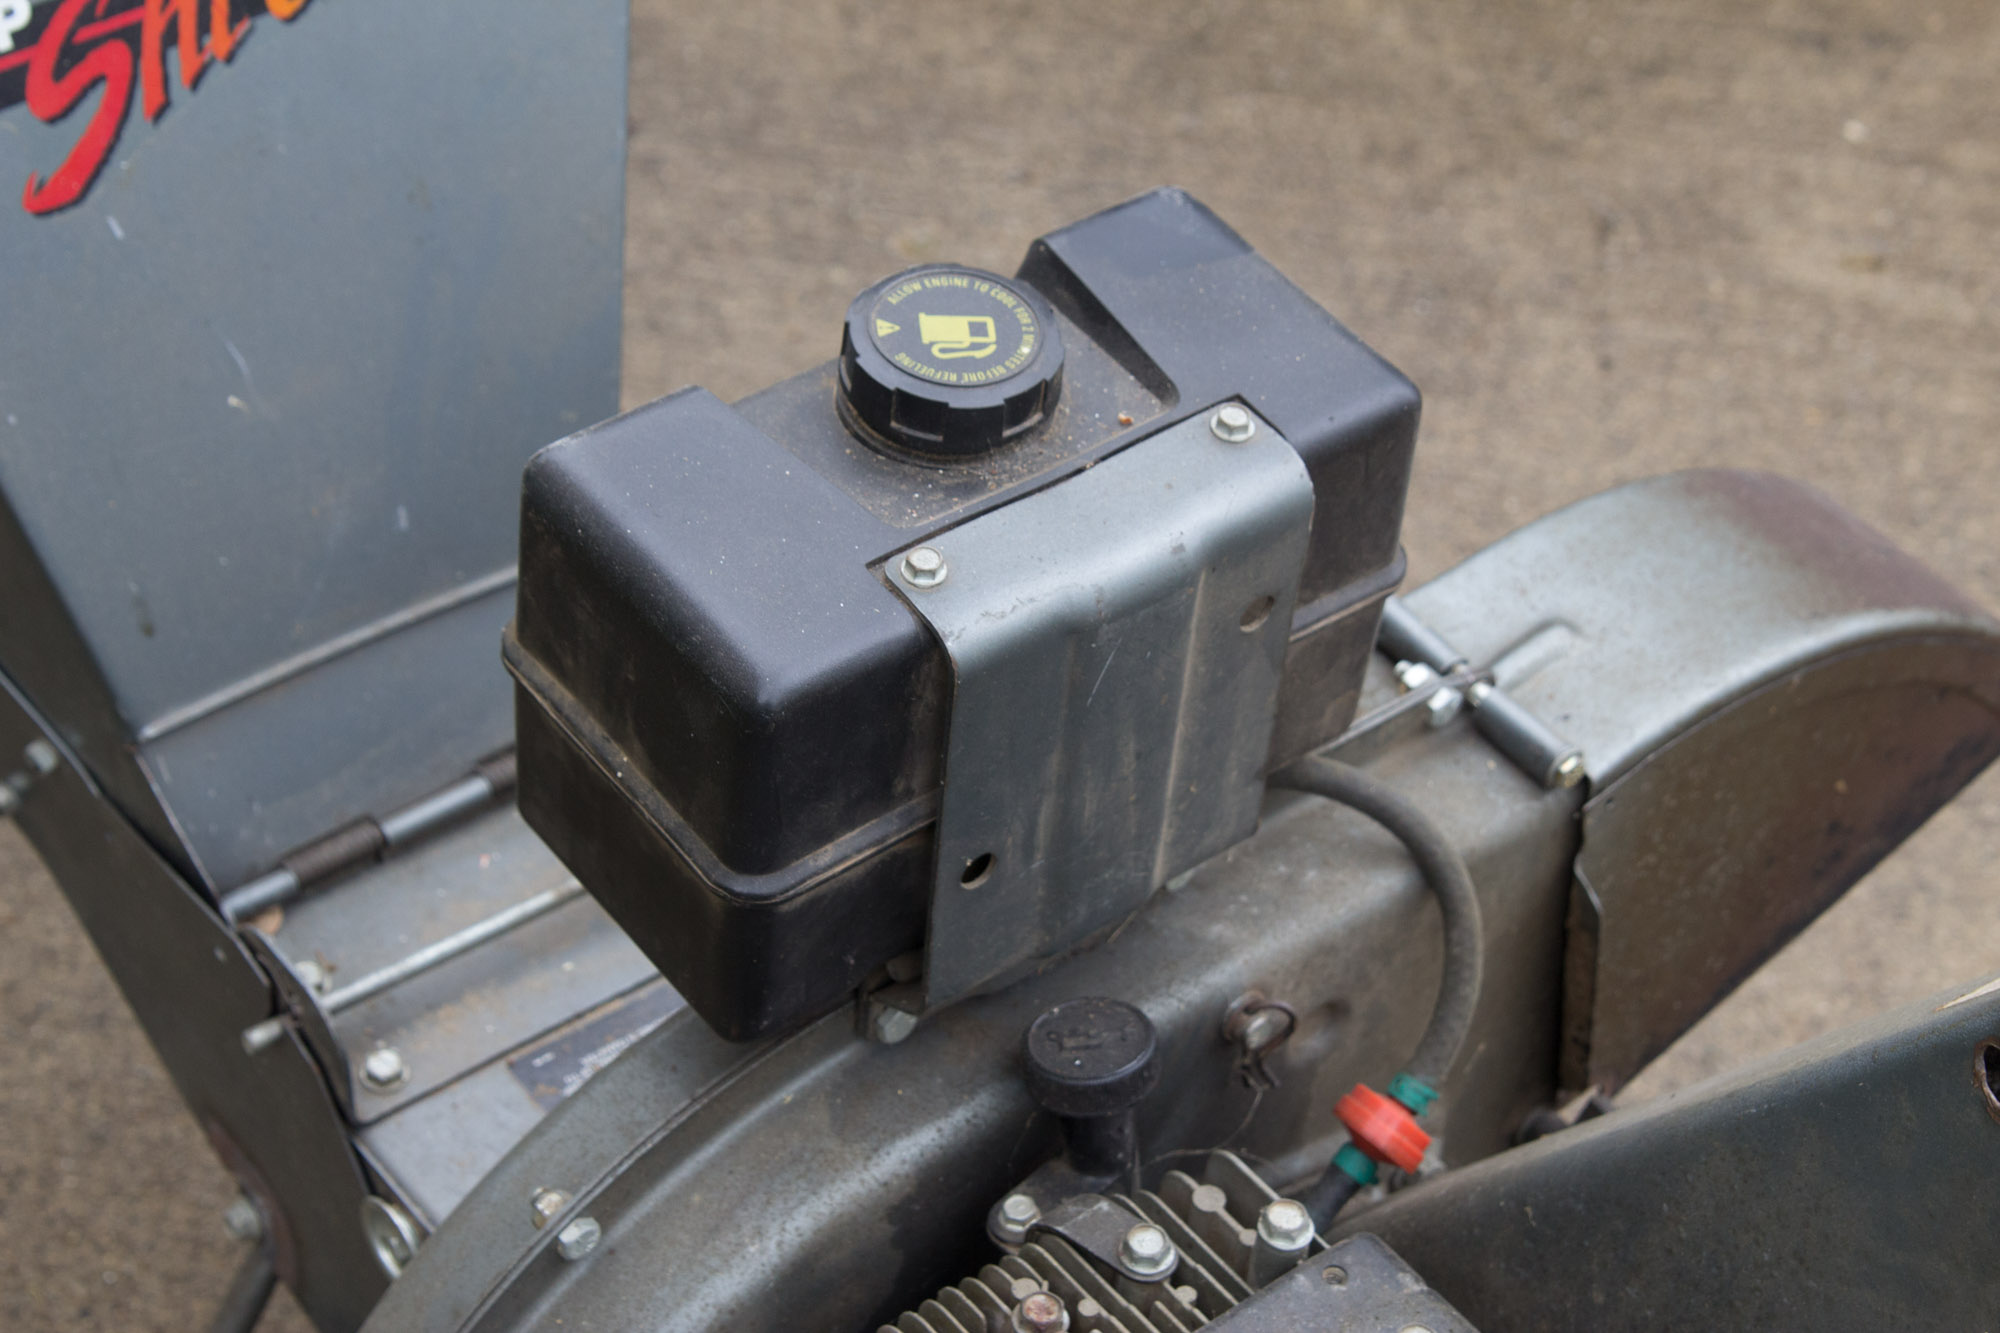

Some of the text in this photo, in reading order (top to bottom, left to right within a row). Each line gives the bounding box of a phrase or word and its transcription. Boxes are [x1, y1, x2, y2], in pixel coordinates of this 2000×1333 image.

[924, 276, 968, 289] ENGINE
[974, 281, 989, 292] TO
[887, 282, 922, 305] ALLOW
[991, 287, 1016, 308] COOL
[1014, 308, 1033, 324] FOR
[894, 352, 957, 382] REFUELING
[961, 364, 1006, 382] BEFORE
